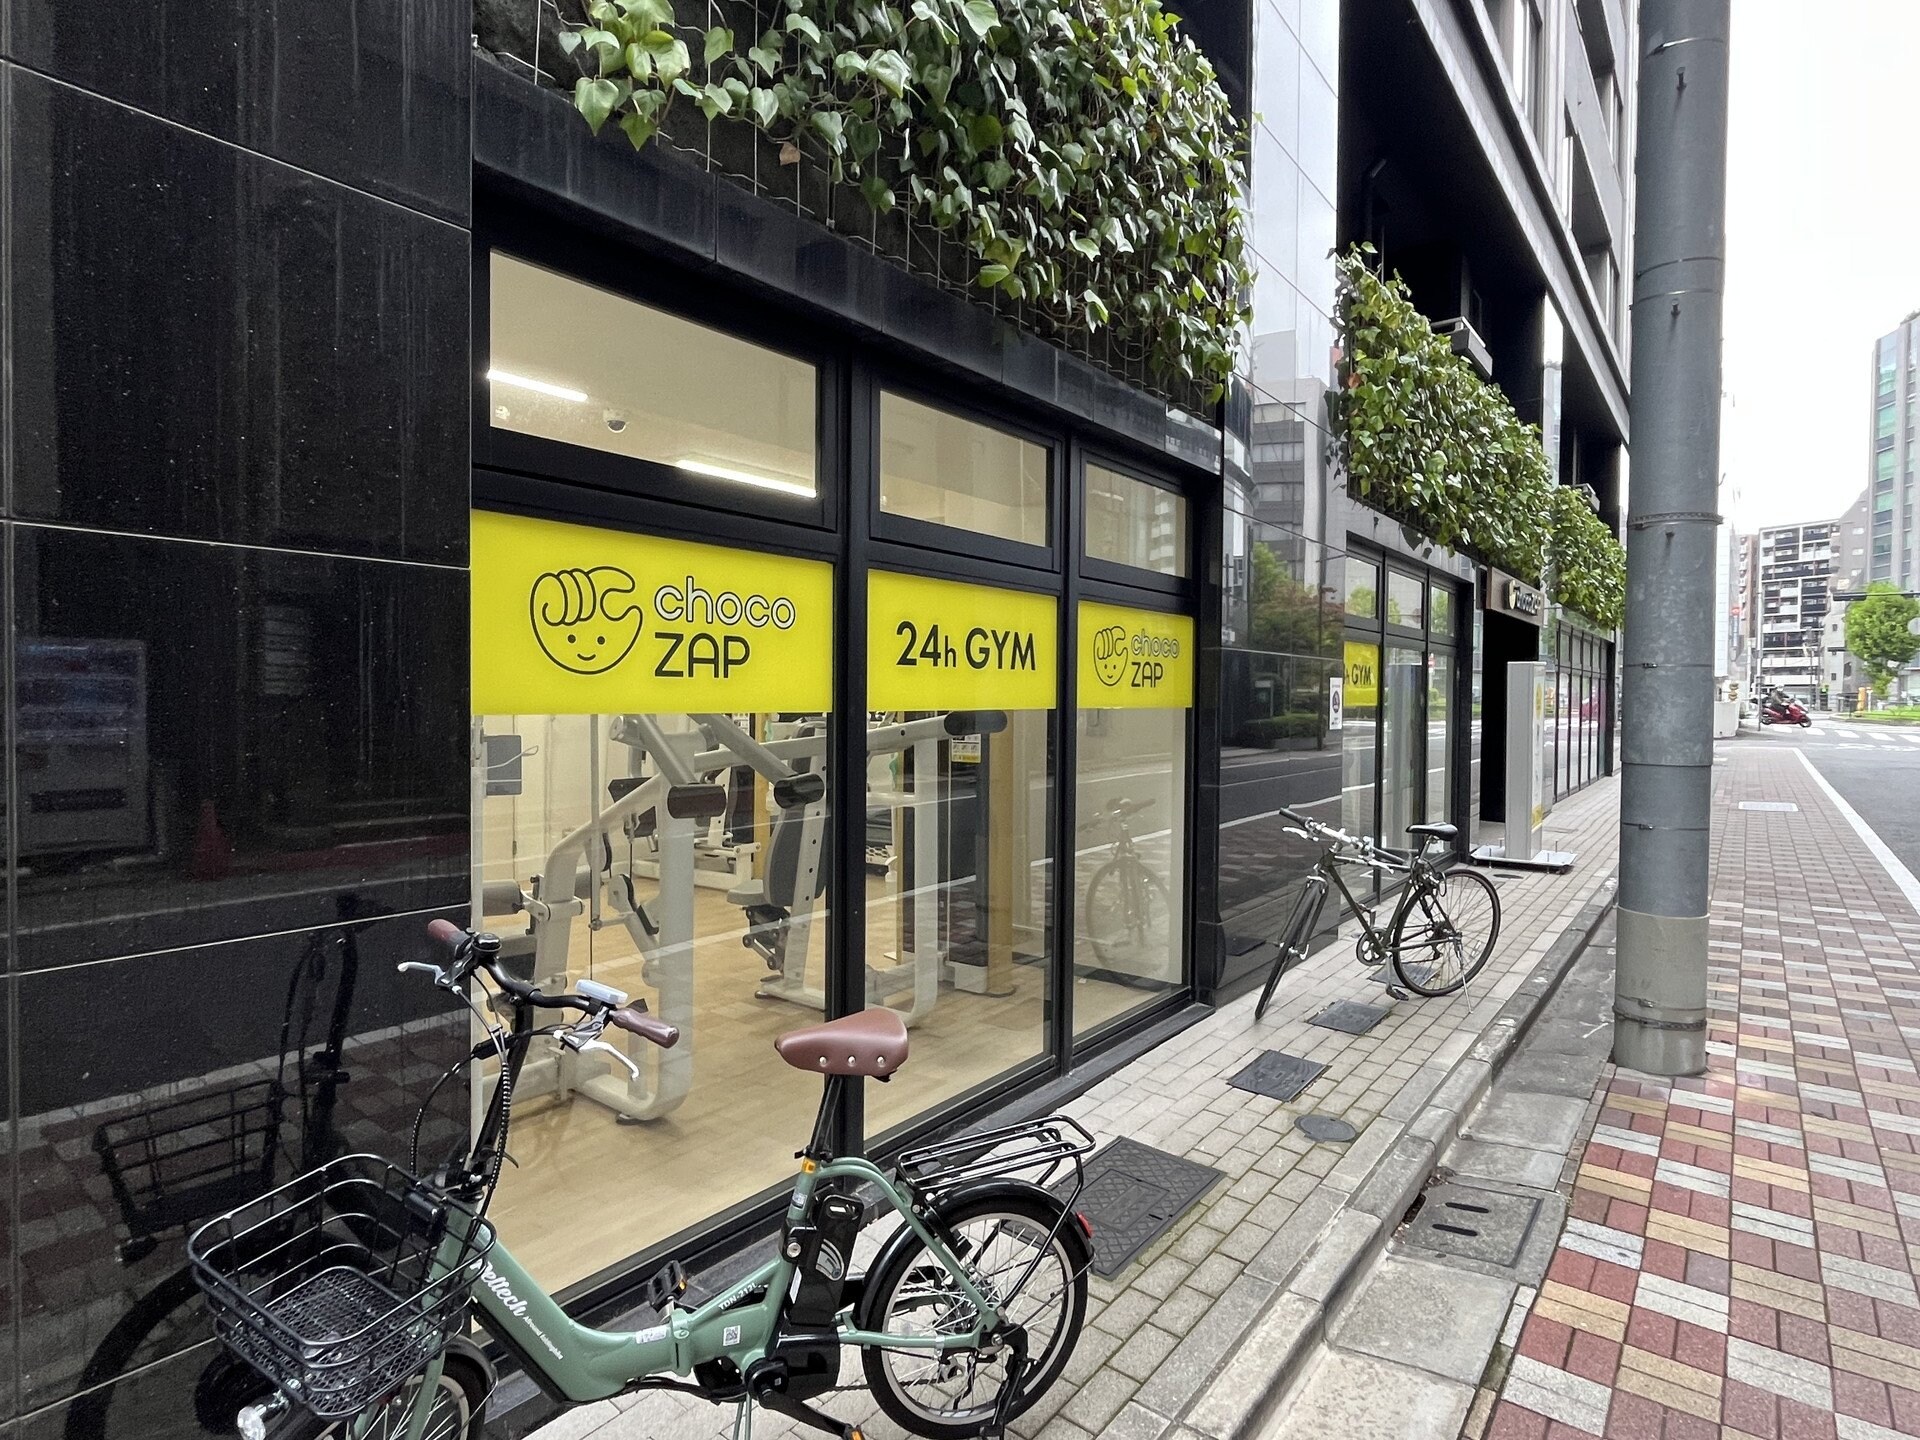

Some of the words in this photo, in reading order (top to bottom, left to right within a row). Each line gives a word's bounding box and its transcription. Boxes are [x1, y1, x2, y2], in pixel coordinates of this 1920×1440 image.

[654, 575, 796, 630] choco
[654, 632, 751, 679] ZAP
[896, 621, 957, 669] 24h
[965, 628, 1037, 672] GYM
[1131, 628, 1180, 659] choco
[1131, 661, 1164, 688] ZAP
[1352, 663, 1372, 685] GYM
